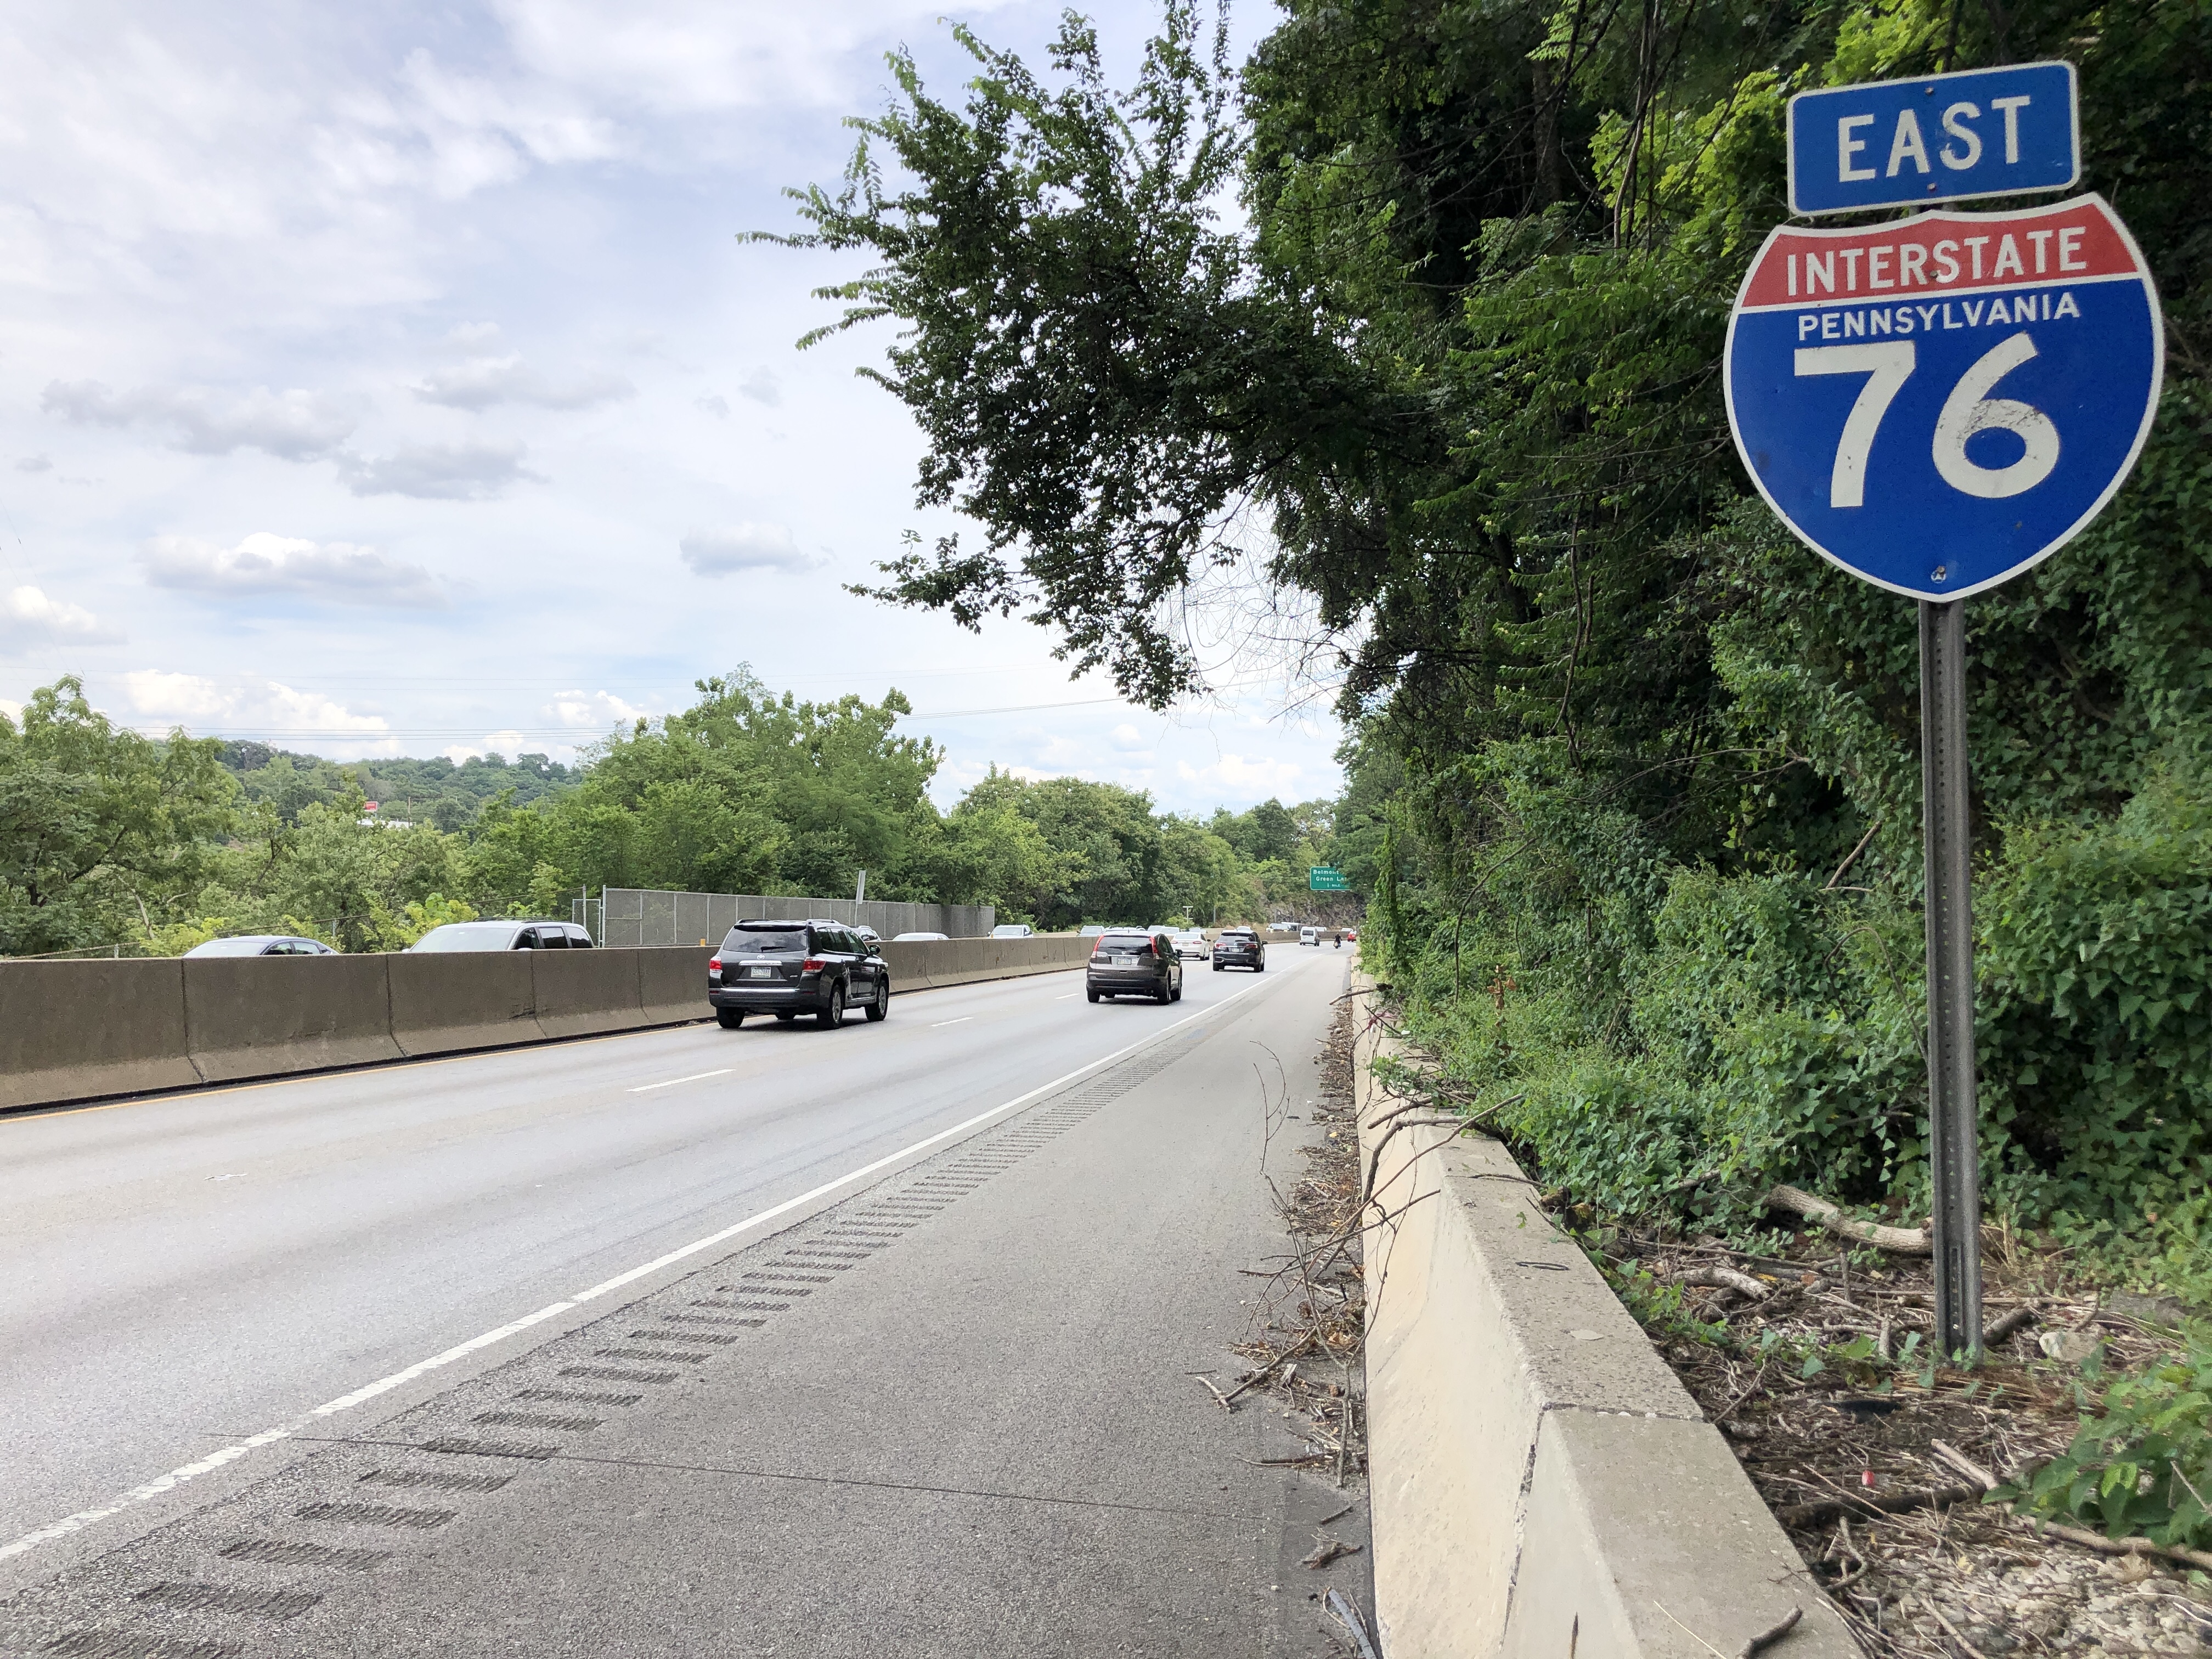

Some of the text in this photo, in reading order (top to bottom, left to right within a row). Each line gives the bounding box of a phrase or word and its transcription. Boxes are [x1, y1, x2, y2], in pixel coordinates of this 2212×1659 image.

[1837, 95, 2031, 183] EAST
[1787, 225, 2087, 297] INTERSTATE
[1798, 292, 2081, 341] PENNSYLVANIA
[1794, 331, 2061, 508] 76
